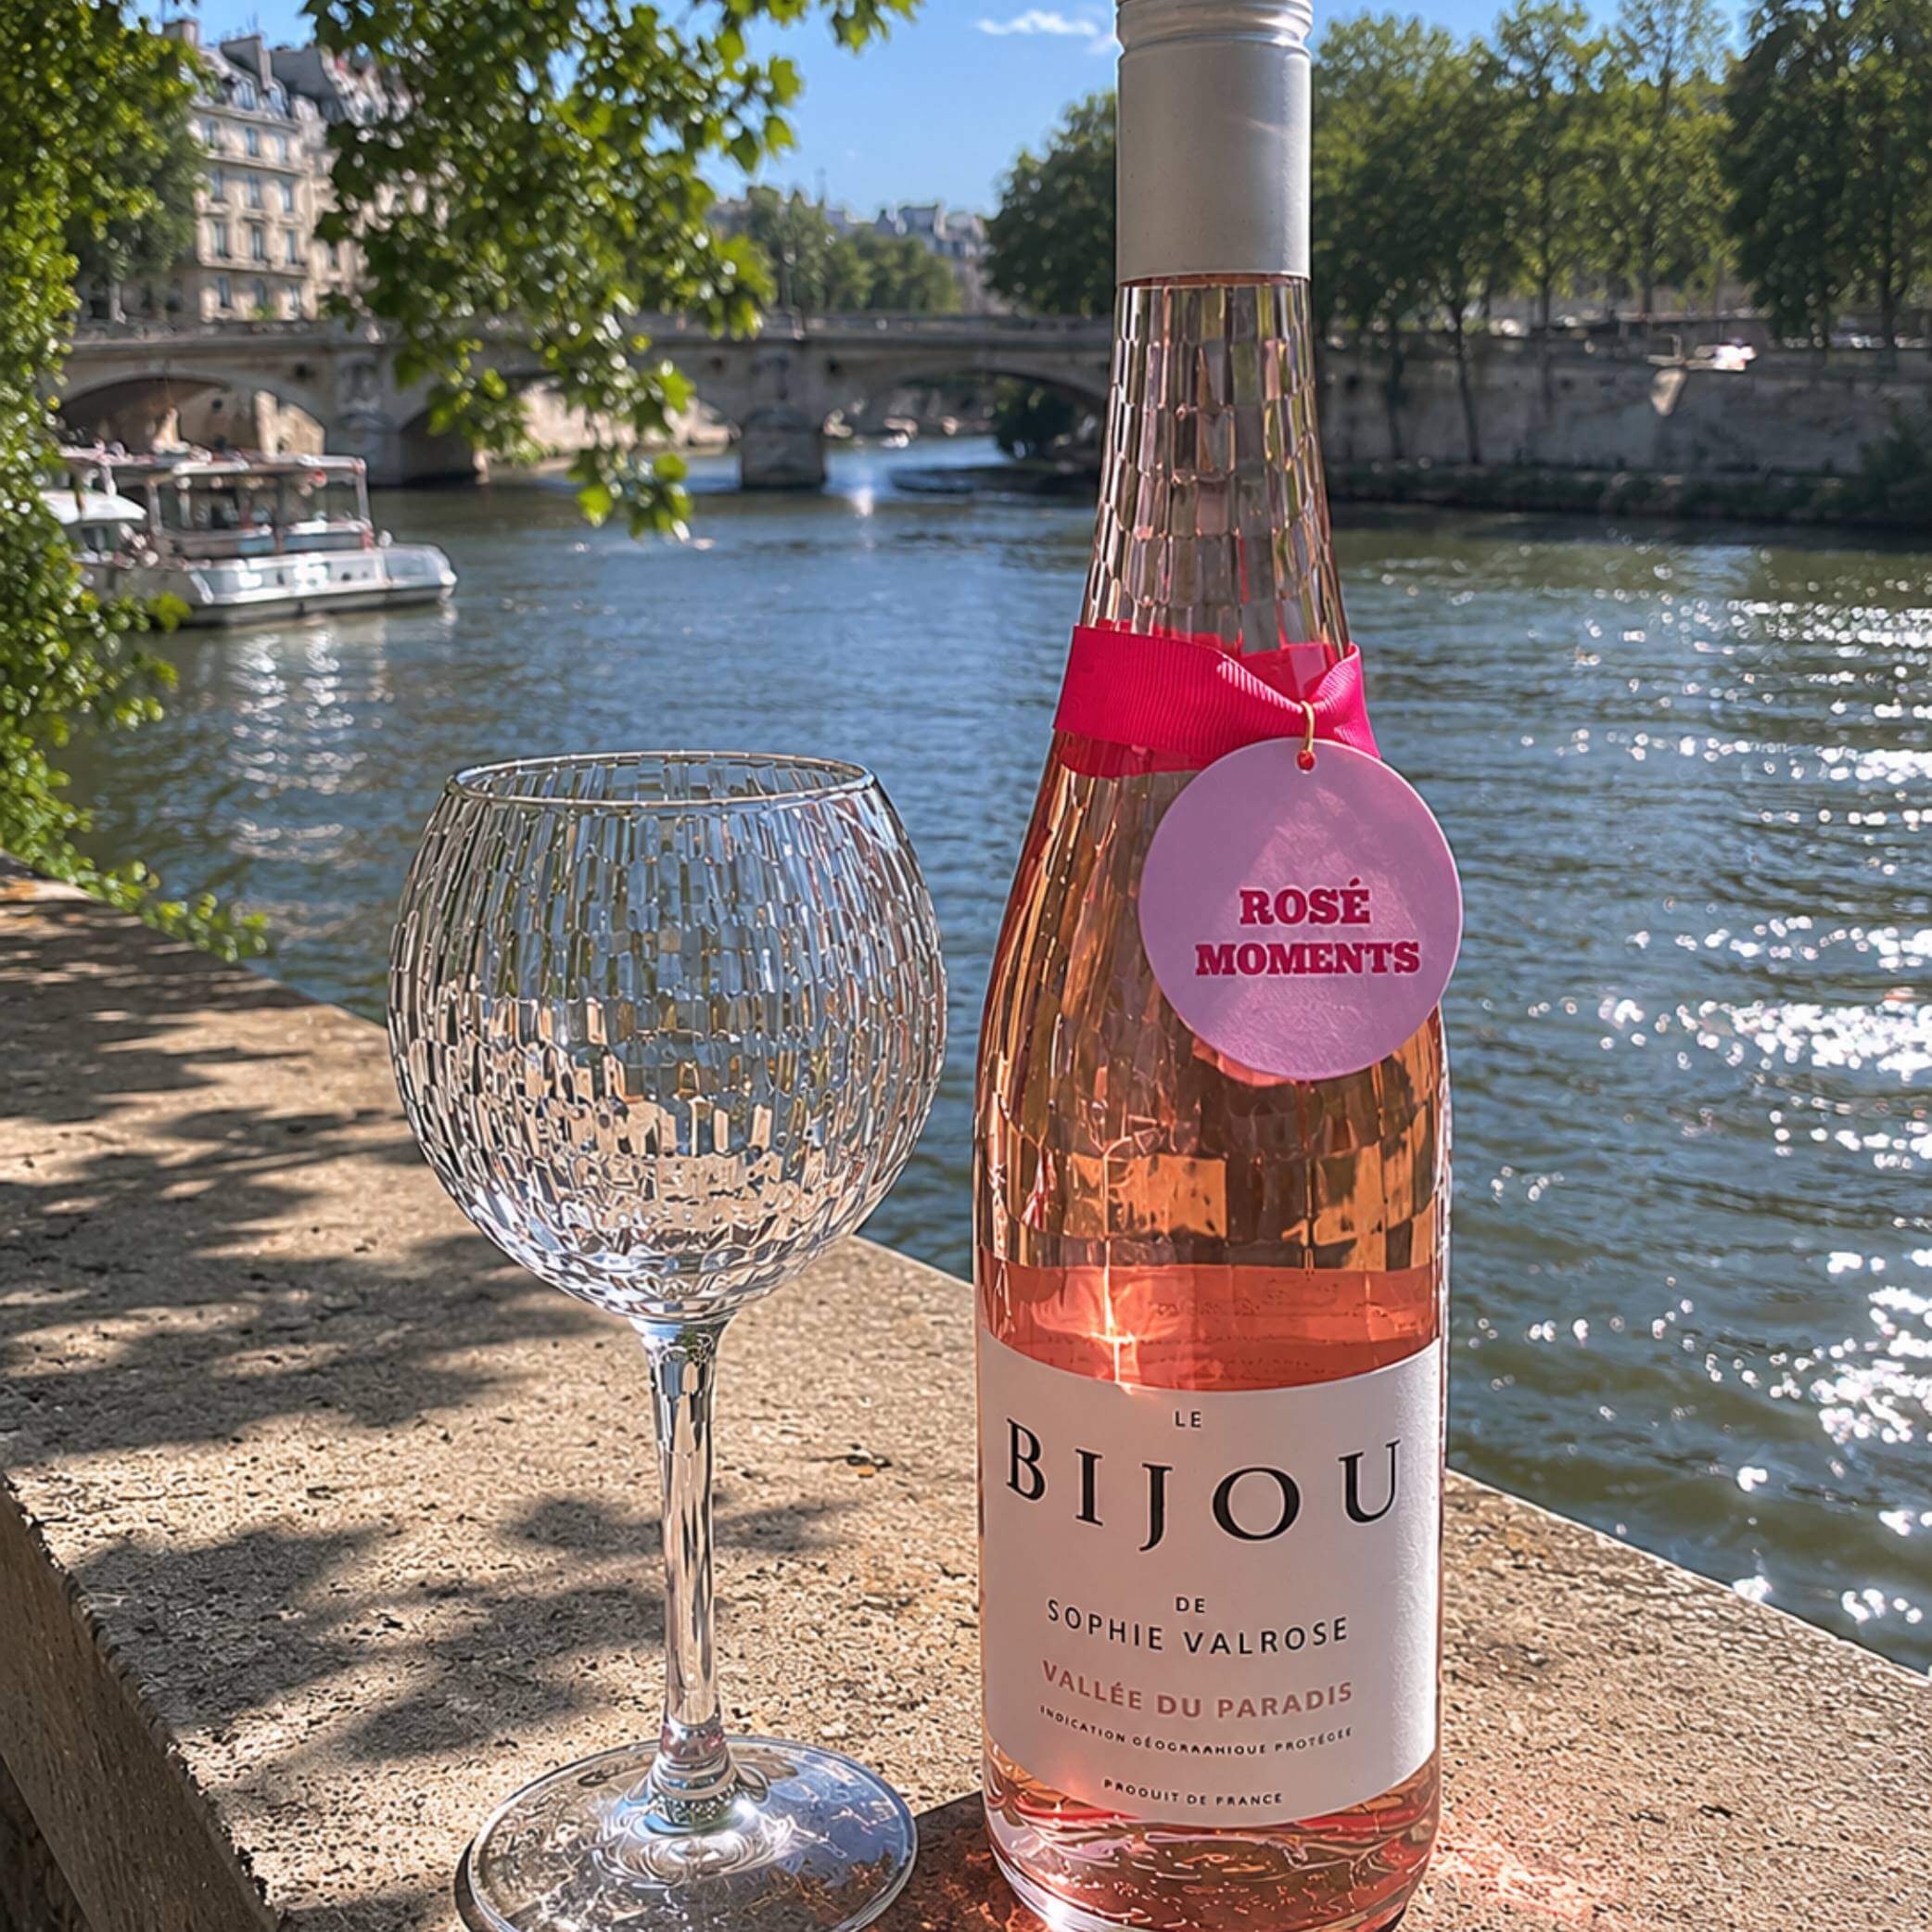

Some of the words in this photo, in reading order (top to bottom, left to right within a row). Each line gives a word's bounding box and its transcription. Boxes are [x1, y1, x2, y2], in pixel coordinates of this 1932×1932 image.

[1239, 877, 1371, 925] ROSÉ
[1194, 941, 1421, 976] MOMENTS
[1174, 1410, 1202, 1429] LE
[1005, 1417, 1402, 1552] BIJOU
[1175, 1596, 1206, 1613] DE
[1047, 1599, 1163, 1651] SOPHIE
[1182, 1616, 1348, 1655] VALROSE
[1040, 1659, 1142, 1710] VALLÉE
[1157, 1695, 1202, 1719] DU
[1216, 1682, 1353, 1719] PARADIS
[1039, 1704, 1126, 1744] INDICATION
[1103, 1778, 1179, 1803] PRODUIT
[1186, 1793, 1207, 1806] DE
[1214, 1792, 1283, 1806] FRANCE
